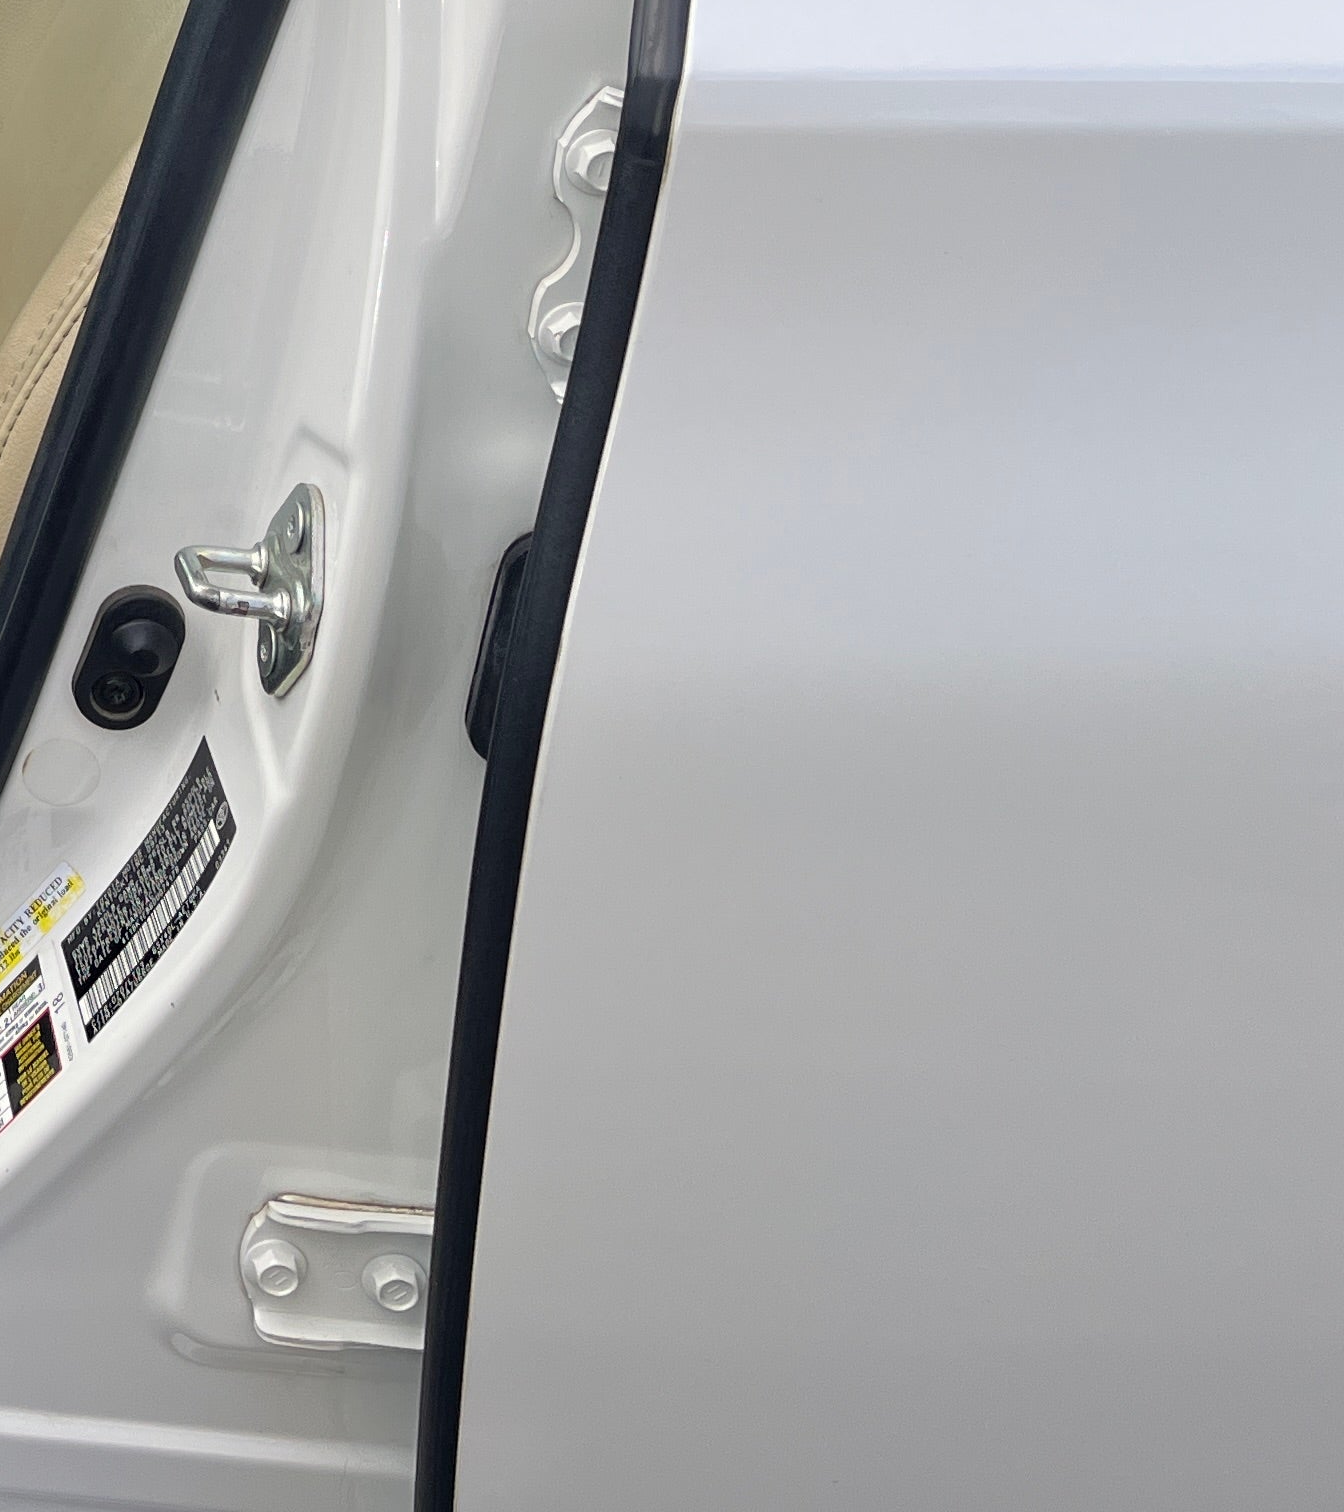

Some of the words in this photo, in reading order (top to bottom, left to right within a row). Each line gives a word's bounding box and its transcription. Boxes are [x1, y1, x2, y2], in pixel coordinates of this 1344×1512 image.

[19, 925, 31, 938] the
[32, 898, 59, 925] original
[56, 879, 74, 898] load
[24, 877, 63, 918] REDUCED
